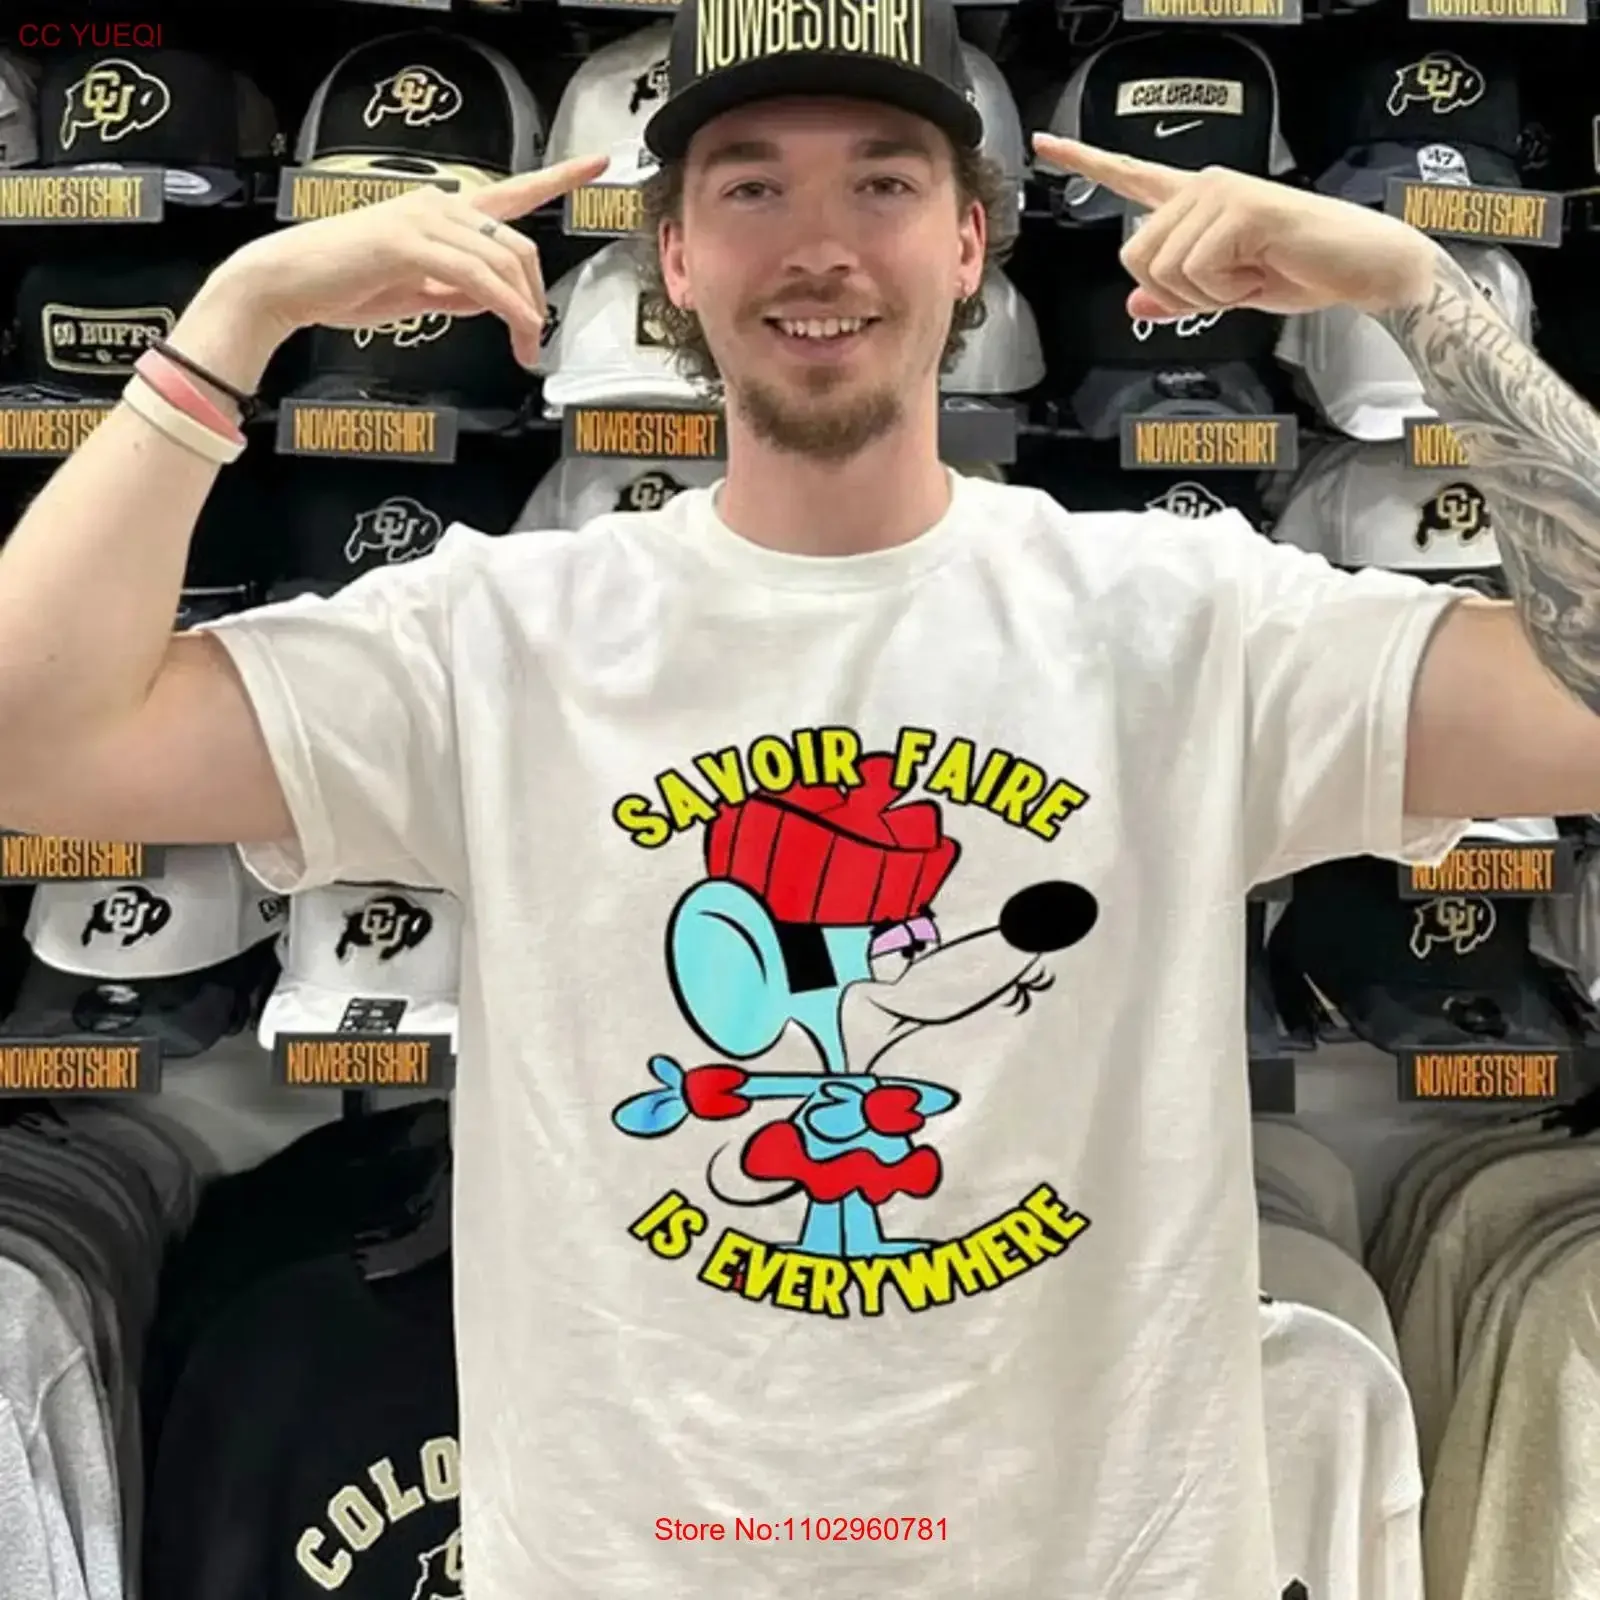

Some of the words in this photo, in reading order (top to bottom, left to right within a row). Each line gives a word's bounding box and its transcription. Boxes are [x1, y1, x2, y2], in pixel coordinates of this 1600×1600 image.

[1132, 83, 1229, 106] COLORADO
[2, 176, 144, 218] NOWBESTSHIRT
[1404, 185, 1548, 238] NOWBESTSHIRT
[294, 408, 436, 453] NOWBESTSHIRT
[575, 410, 718, 456] NOWBESTSHIRT
[1136, 421, 1279, 464] NOWBESTSHIRT
[612, 725, 862, 848] SAVOIR
[893, 726, 1091, 842] FAIRE
[2, 835, 143, 877] NOWBESTSHIRT
[287, 1041, 430, 1083] NOWBESTSHIRT
[1415, 1054, 1559, 1096] NOWBESTSHIRT
[628, 1188, 709, 1260] IS
[697, 1181, 1092, 1318] EVERYWHERE
